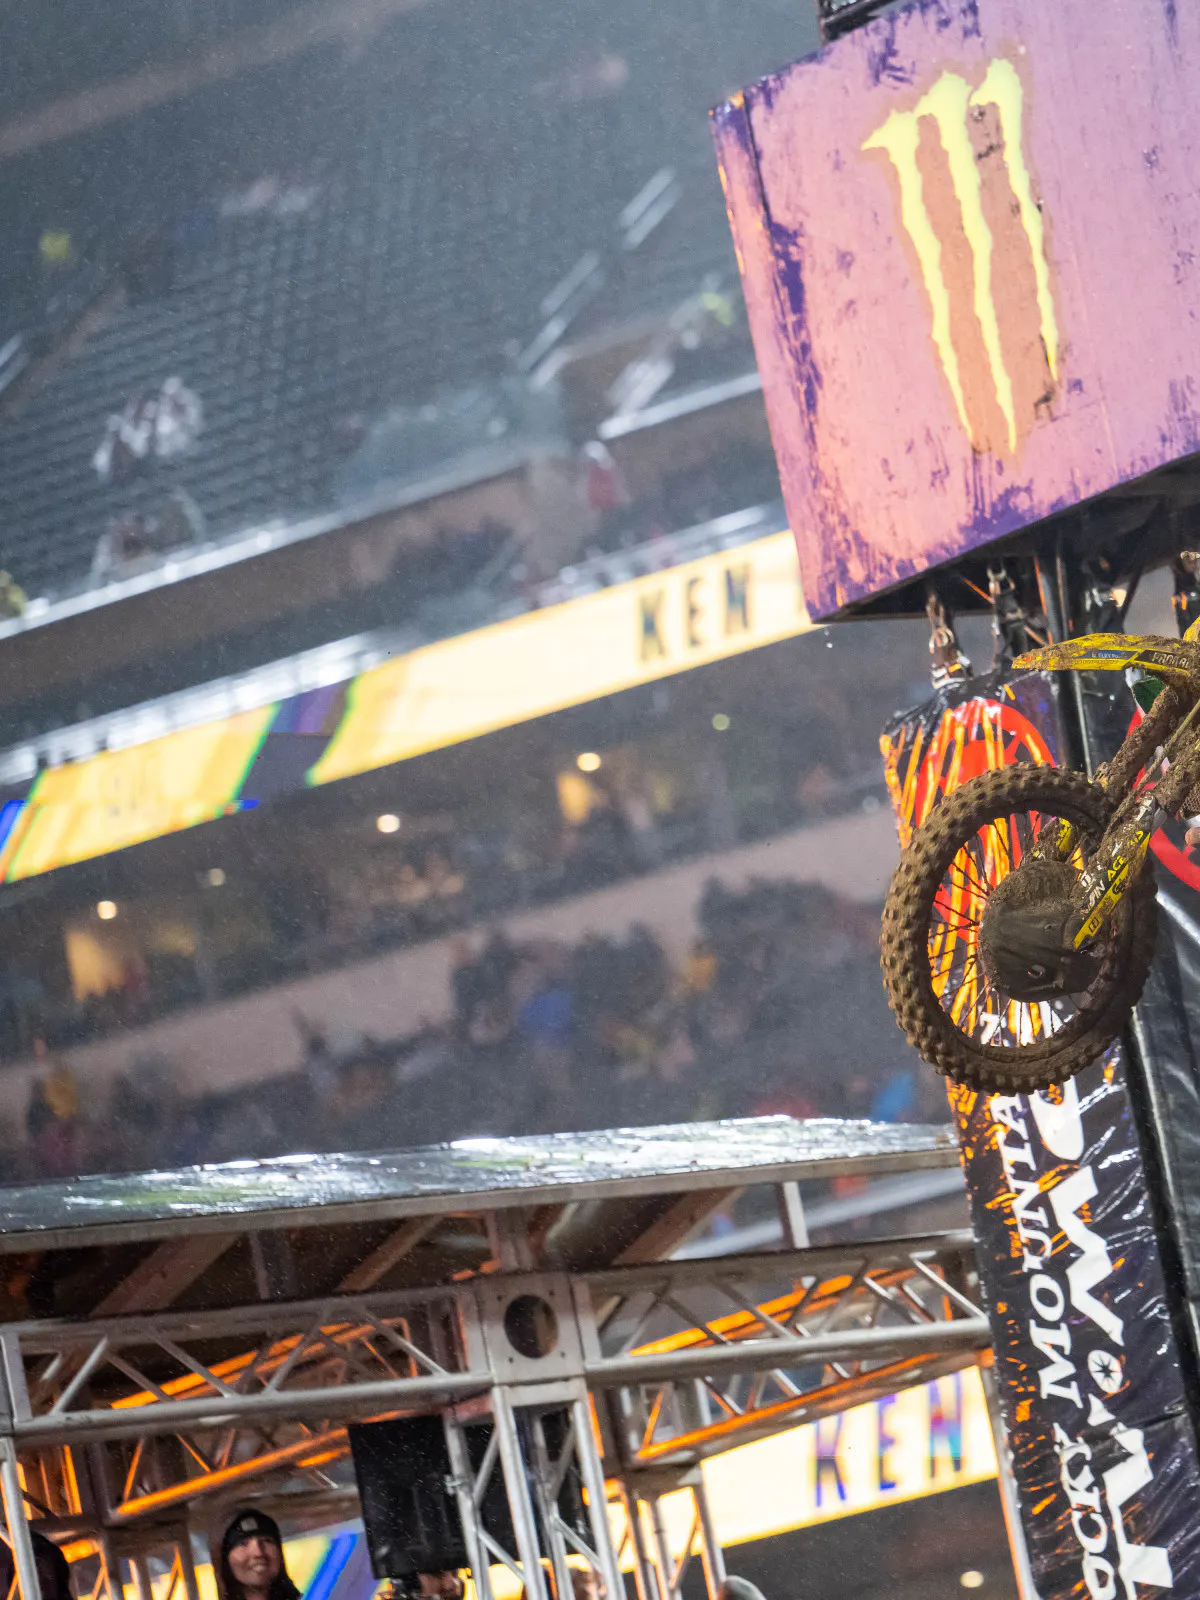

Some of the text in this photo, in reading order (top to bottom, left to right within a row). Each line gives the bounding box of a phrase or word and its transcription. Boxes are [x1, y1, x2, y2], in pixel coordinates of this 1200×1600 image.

[638, 563, 752, 663] KEN
[813, 1371, 962, 1507] KEN
[1053, 1422, 1116, 1600] OCKY
